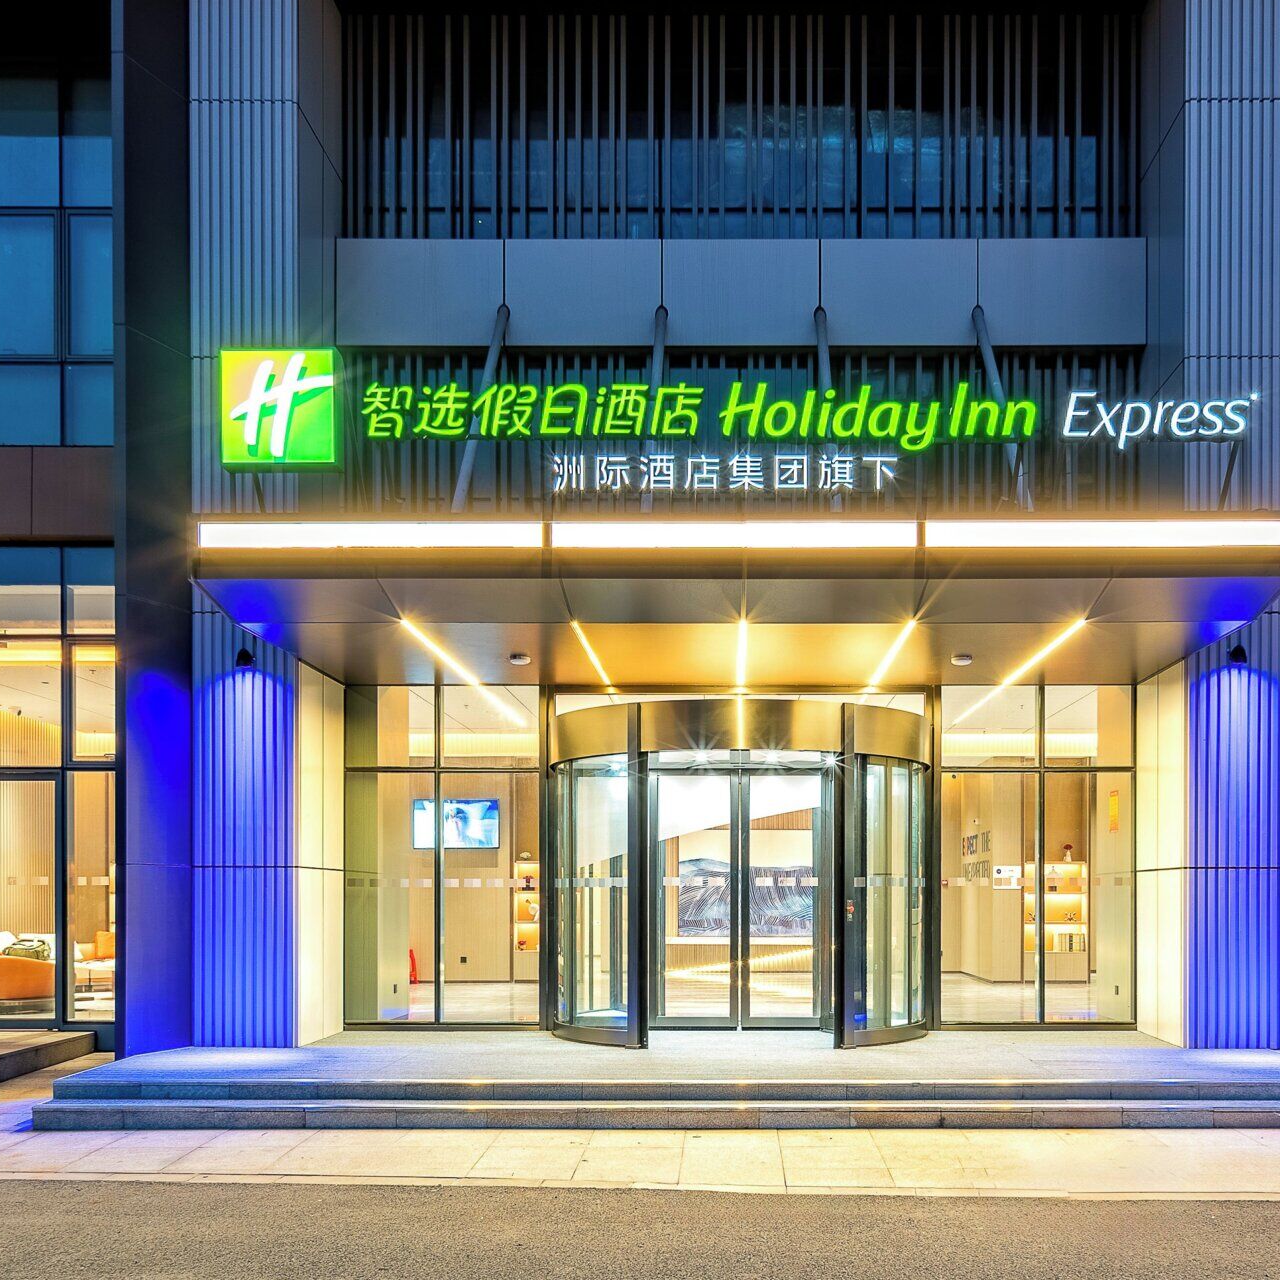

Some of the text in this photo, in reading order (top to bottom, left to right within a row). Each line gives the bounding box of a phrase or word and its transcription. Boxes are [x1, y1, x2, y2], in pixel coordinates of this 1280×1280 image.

[361, 380, 1251, 452] 智选假日酒店 Holiday Inn Express
[552, 453, 900, 493] 洲际酒店集团旗下
